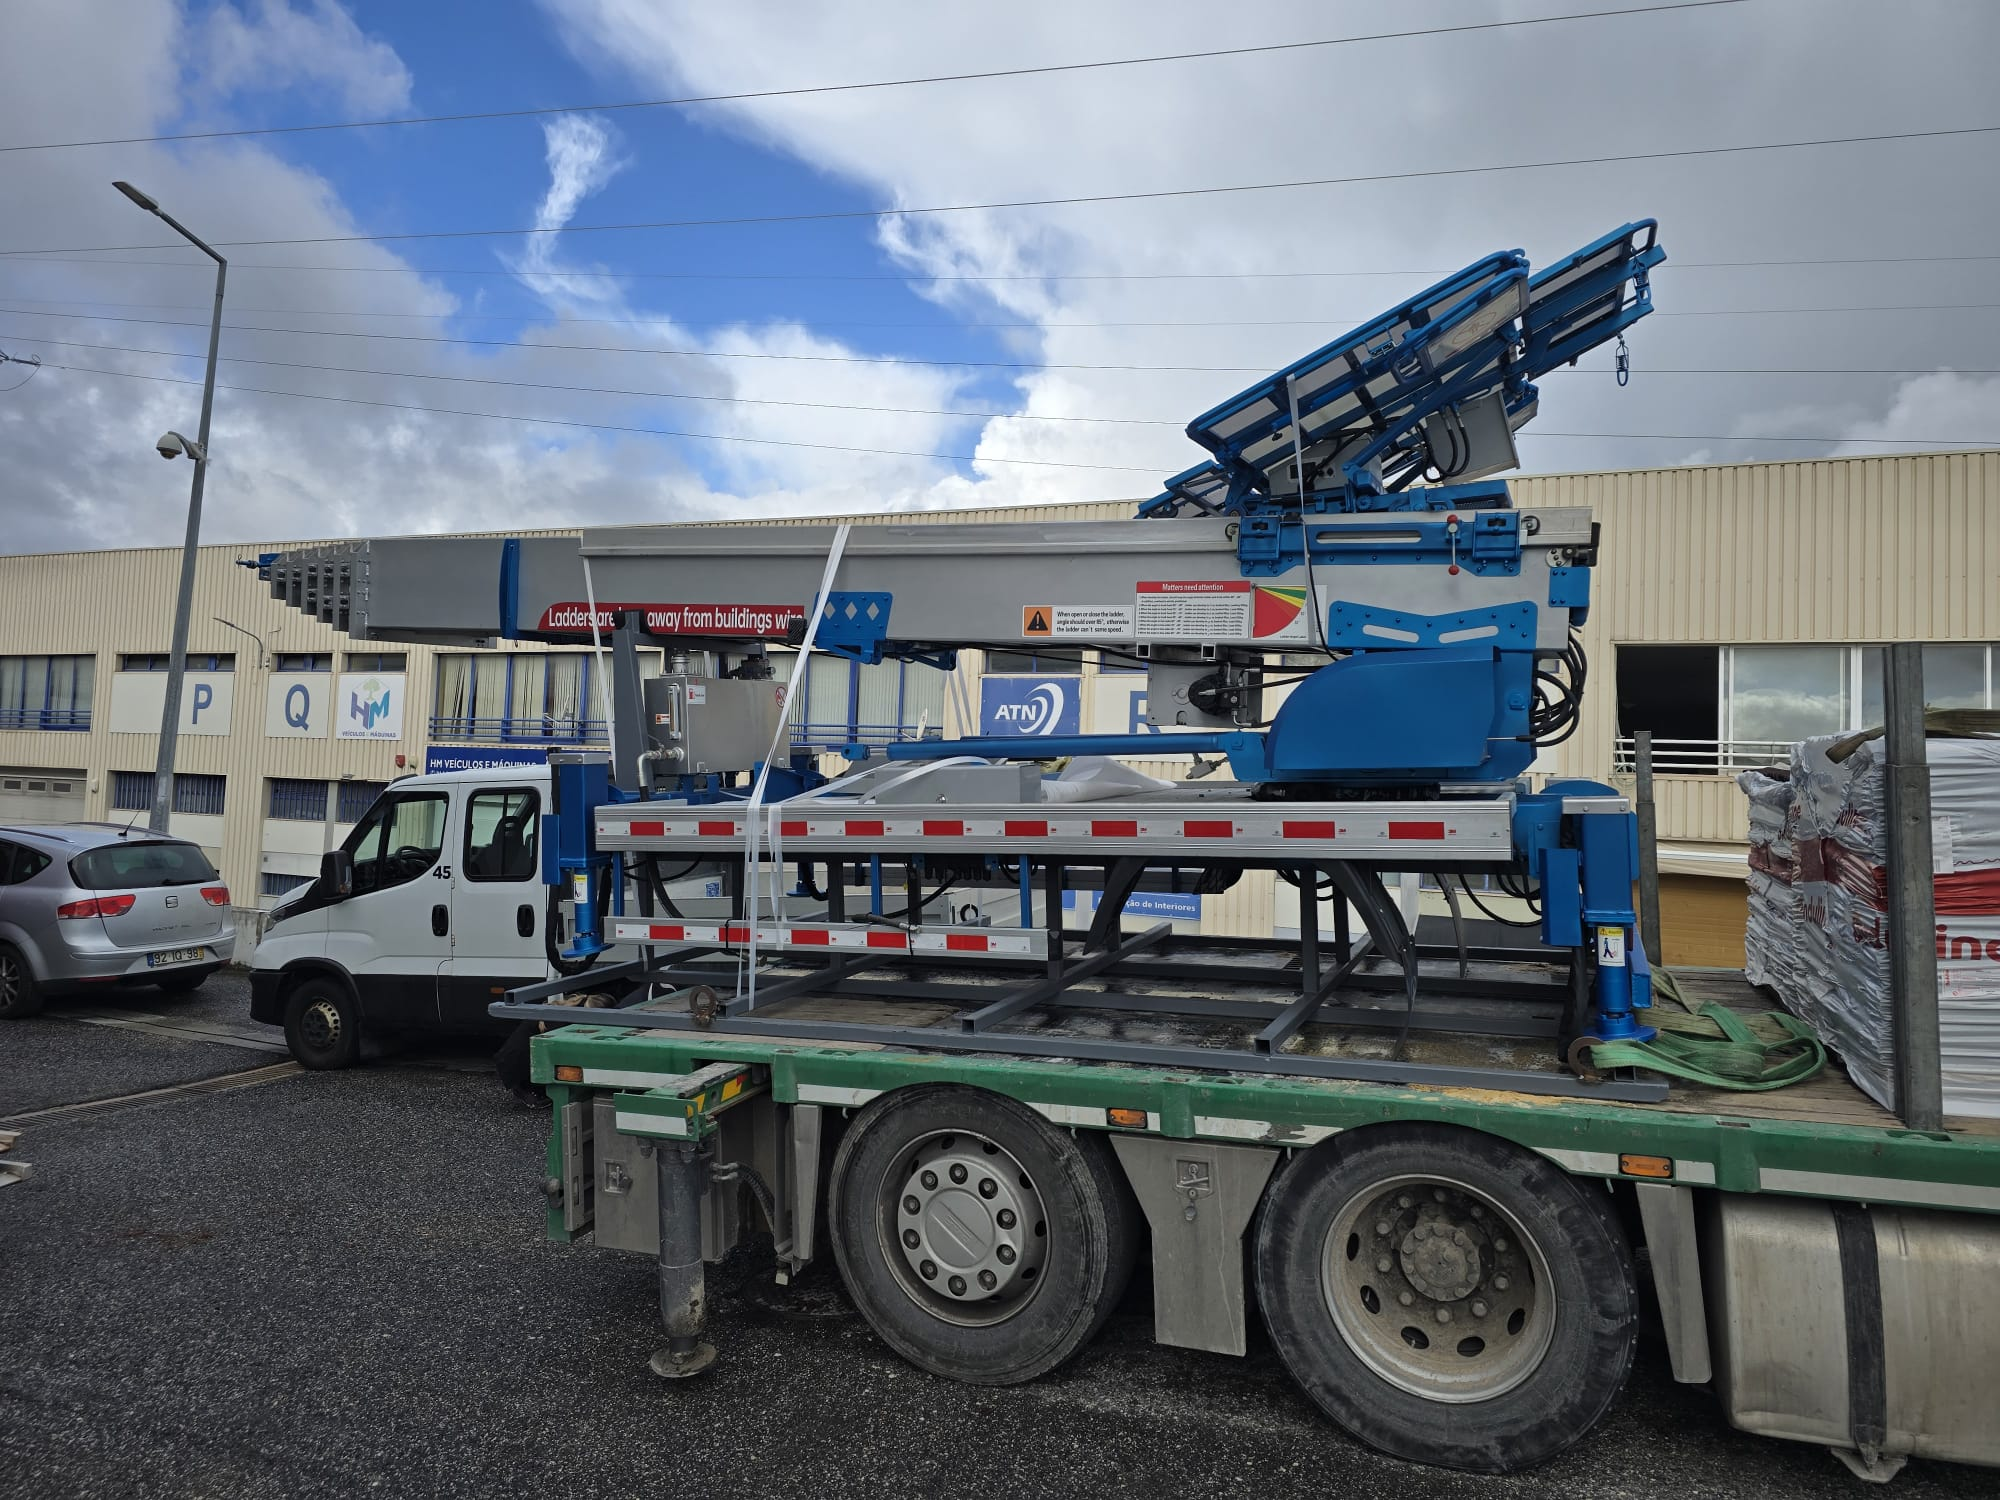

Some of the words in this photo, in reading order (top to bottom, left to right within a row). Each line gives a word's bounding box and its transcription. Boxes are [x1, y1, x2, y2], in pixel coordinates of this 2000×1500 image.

[1162, 583, 1184, 591] Matters
[1184, 583, 1198, 591] need
[1198, 583, 1224, 591] attention
[548, 606, 594, 627] Ladders
[647, 611, 681, 632] away
[683, 606, 713, 628] from
[715, 607, 772, 634] buildings
[192, 683, 213, 725] P
[285, 683, 310, 732] Q
[350, 689, 391, 730] HM
[994, 704, 1038, 721] ATN
[430, 759, 442, 769] HM
[444, 757, 483, 769] VEÍCULOS
[433, 865, 451, 880] 45
[1142, 900, 1153, 908] de
[1154, 901, 1196, 912] Interiores
